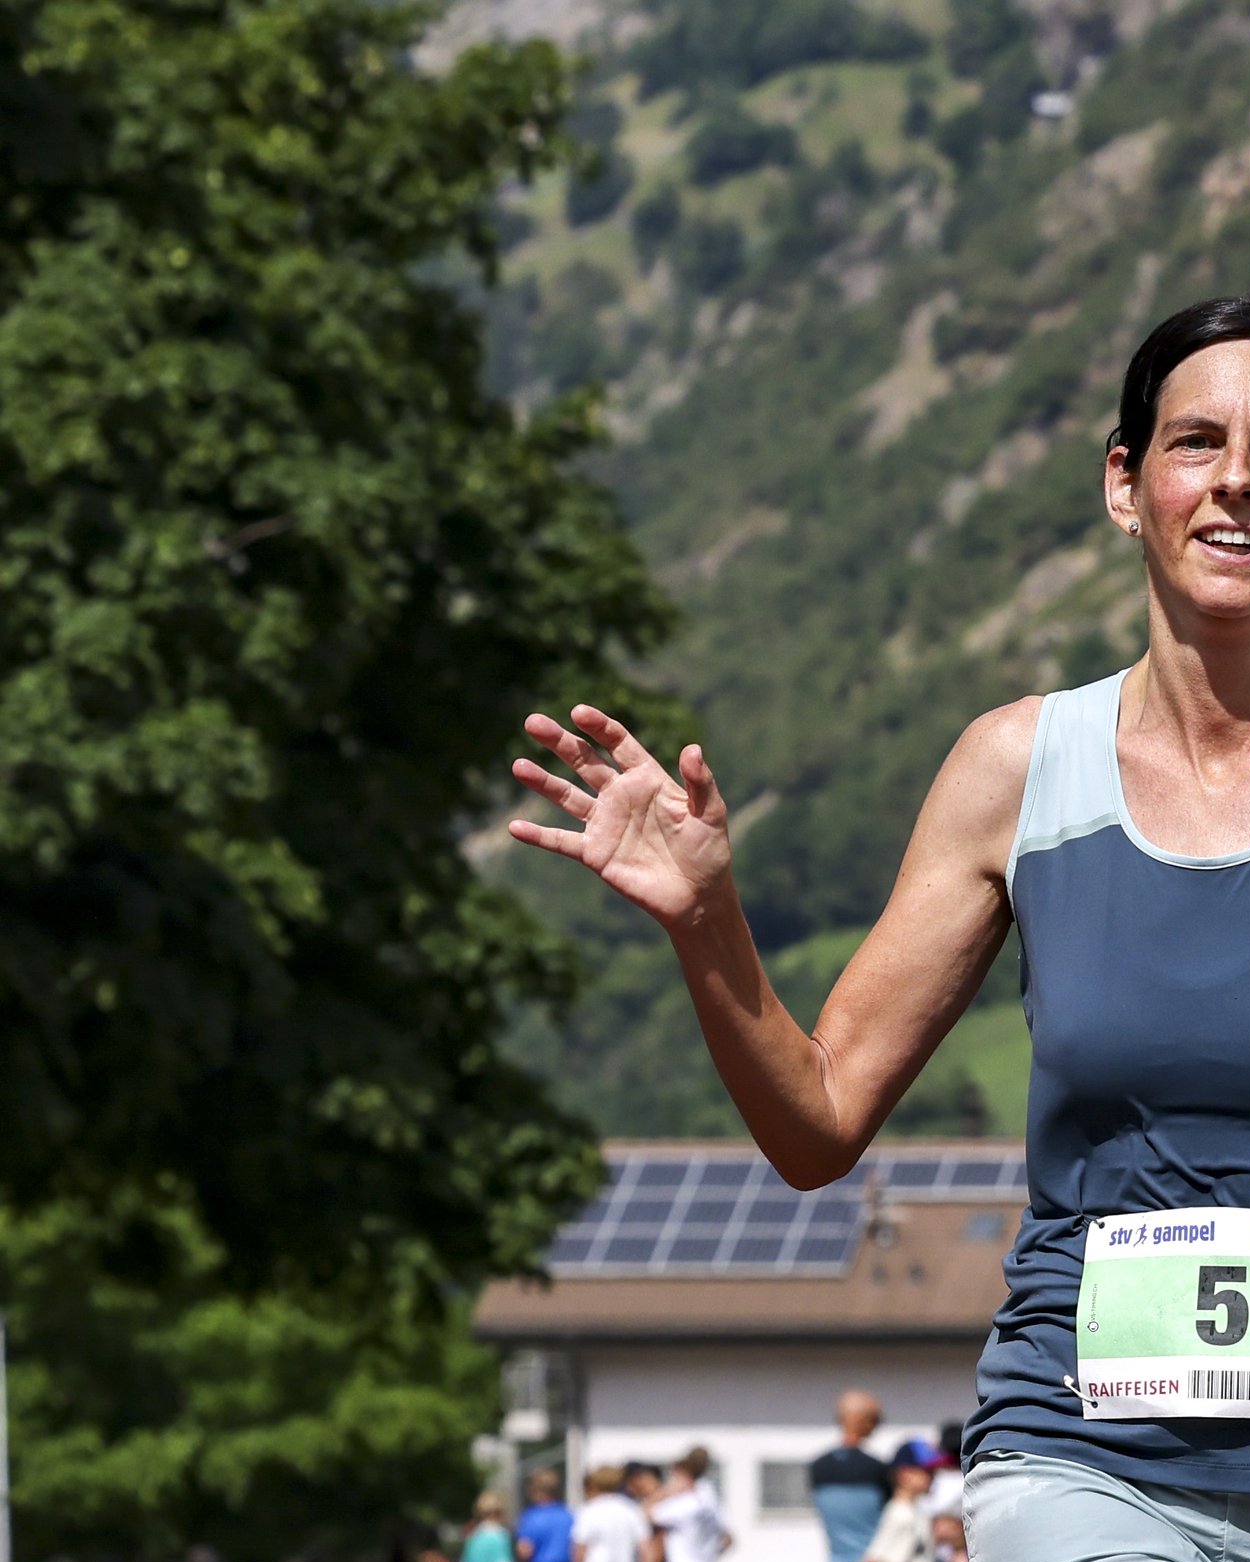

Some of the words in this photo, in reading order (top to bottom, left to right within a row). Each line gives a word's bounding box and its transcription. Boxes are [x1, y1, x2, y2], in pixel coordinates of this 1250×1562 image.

[1109, 1227, 1133, 1246] stv
[1153, 1221, 1215, 1244] gampel
[1195, 1265, 1249, 1346] 5
[1088, 1380, 1179, 1397] RAIFFEISEN
